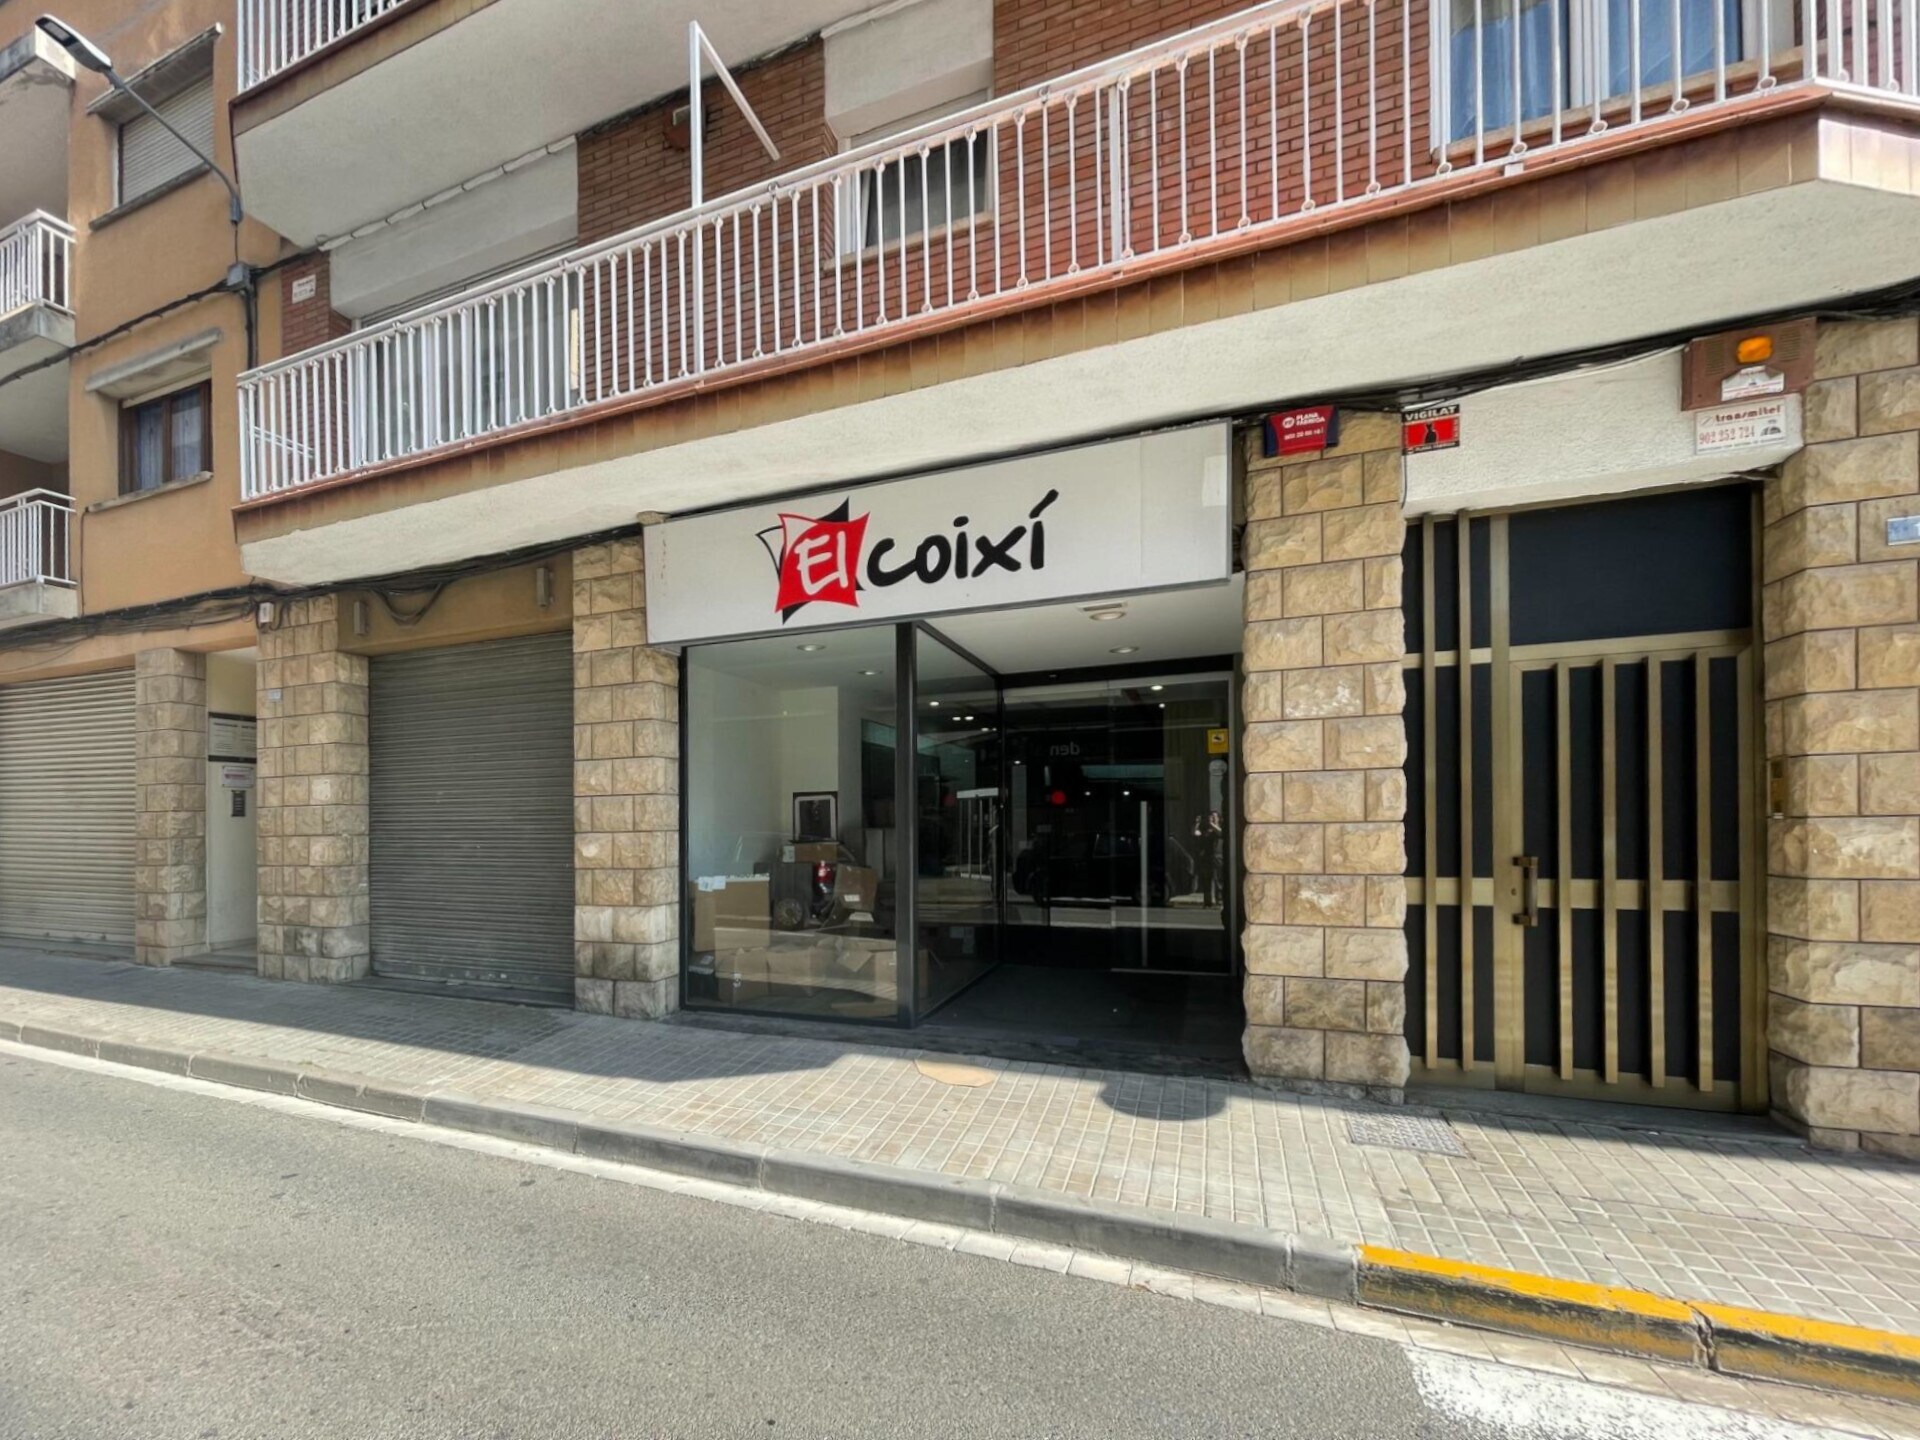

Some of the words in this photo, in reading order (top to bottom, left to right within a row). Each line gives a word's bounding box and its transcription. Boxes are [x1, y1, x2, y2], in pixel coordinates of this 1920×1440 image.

[1405, 406, 1458, 421] VIGILAT
[1699, 430, 1716, 445] 902
[794, 530, 849, 596] El
[867, 489, 1060, 588] coixí
